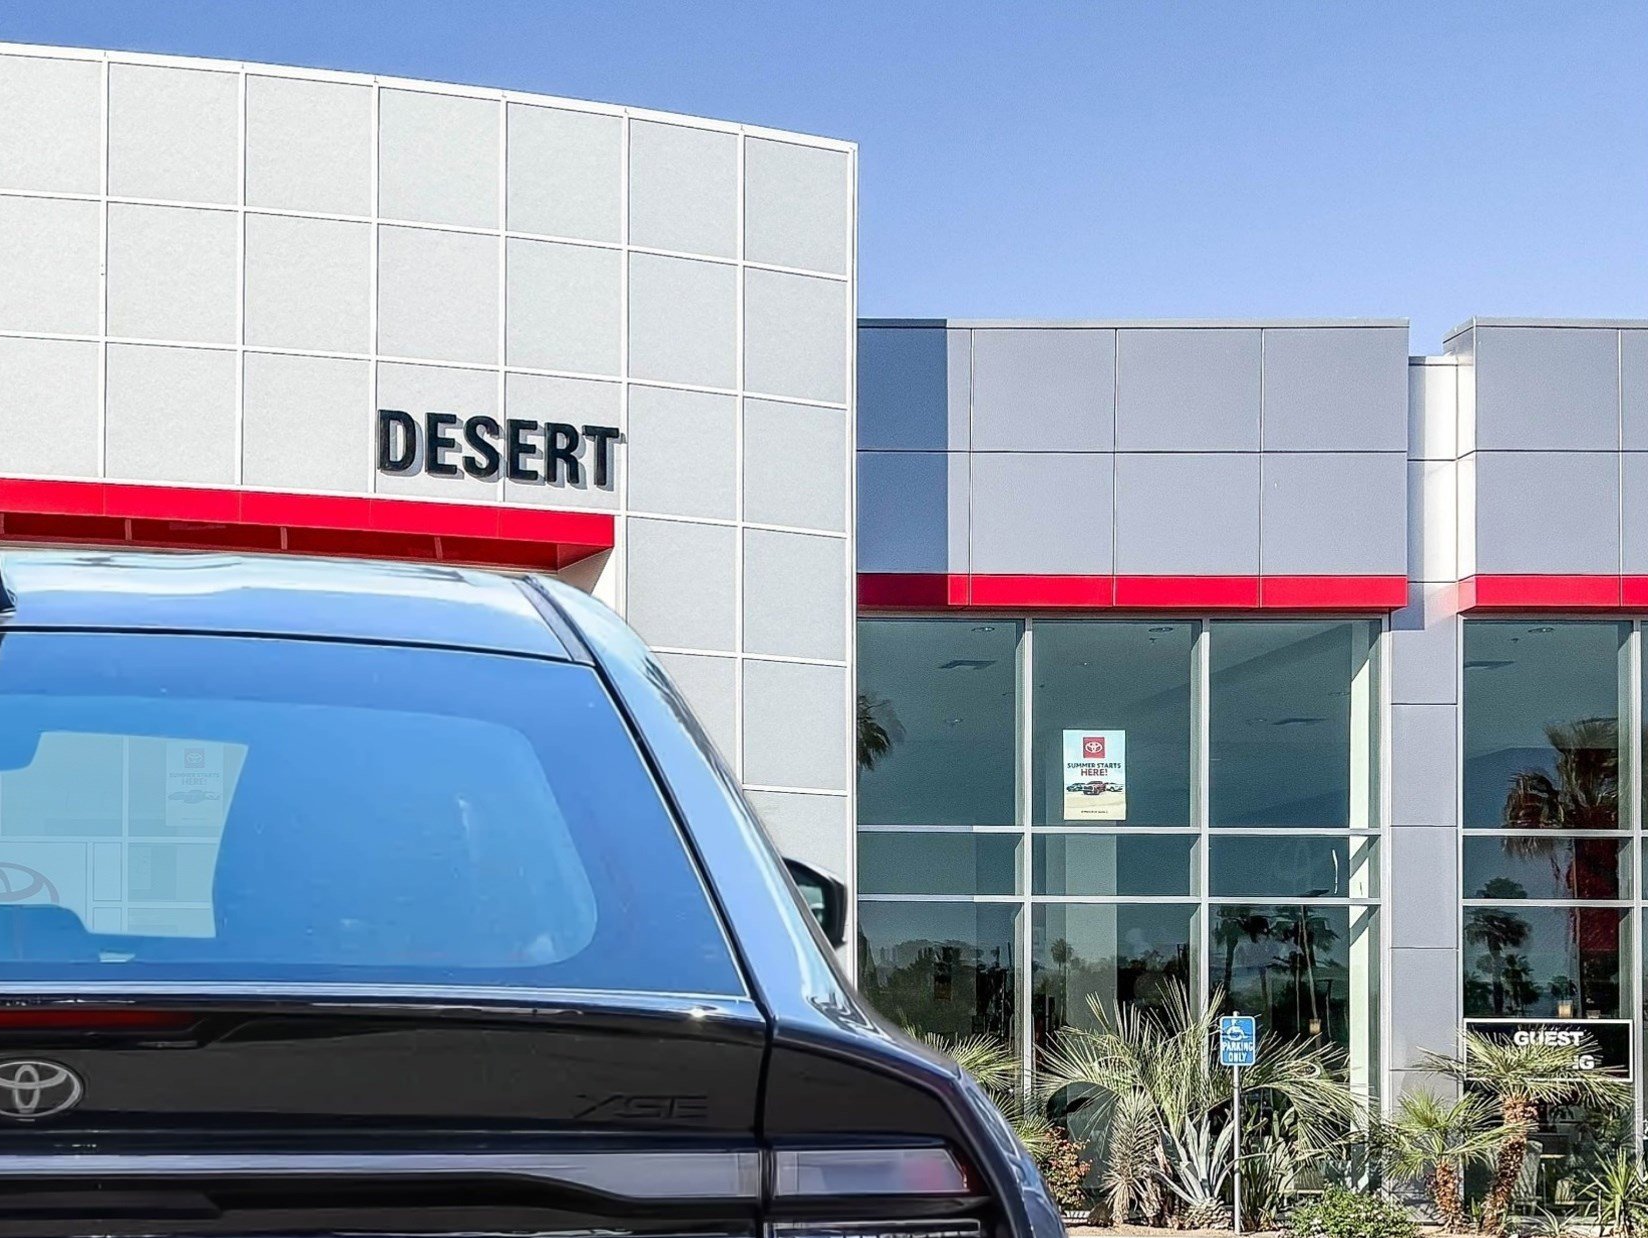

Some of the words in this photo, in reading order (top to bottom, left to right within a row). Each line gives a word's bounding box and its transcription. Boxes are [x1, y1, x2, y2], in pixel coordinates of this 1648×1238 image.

[377, 409, 620, 486] DESERT
[1080, 768, 1108, 776] HERE!
[1513, 1030, 1584, 1047] GUEST
[1222, 1040, 1253, 1051] PARKING
[1228, 1051, 1247, 1062] ONLY
